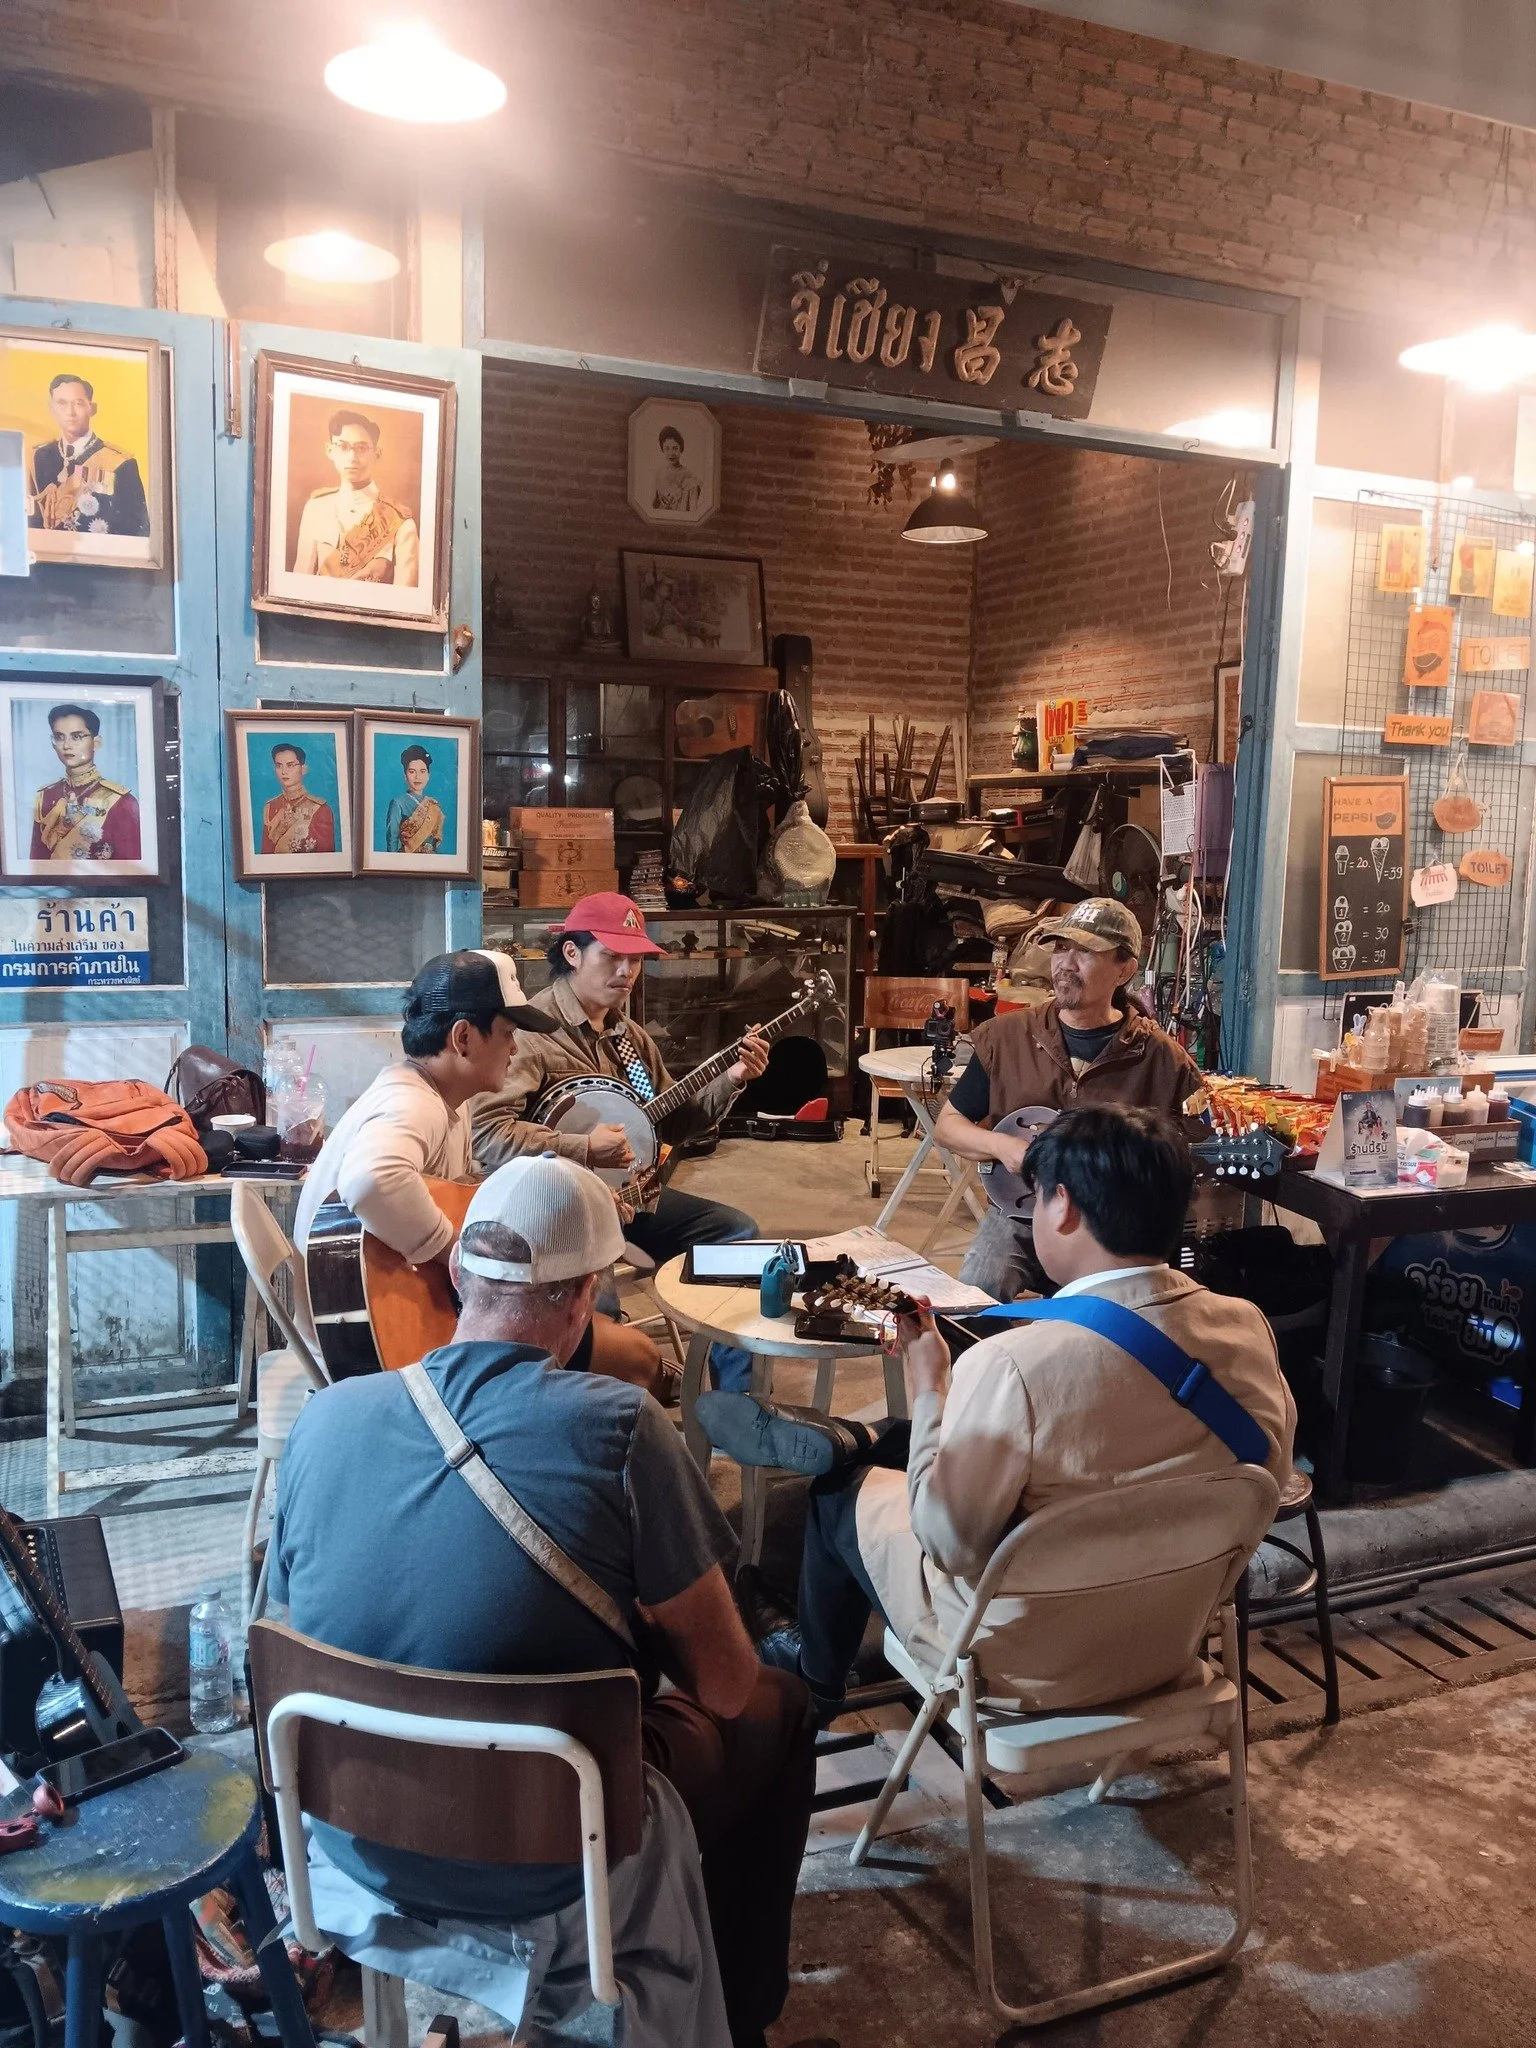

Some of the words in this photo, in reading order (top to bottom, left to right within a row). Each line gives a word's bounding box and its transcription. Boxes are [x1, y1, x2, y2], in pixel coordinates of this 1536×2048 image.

[1391, 721, 1425, 737] Thank
[1427, 726, 1450, 739] you
[1333, 797, 1361, 806] HAVE
[1366, 797, 1373, 806] A
[1333, 812, 1373, 823] PEPSI
[1470, 861, 1508, 876] TOILET
[1376, 901, 1391, 914] 20
[37, 902, 136, 933] ร้านค้า
[1375, 926, 1389, 940] 30
[102, 940, 124, 951] ของ
[2, 954, 141, 977] กรมการค้าภายใน
